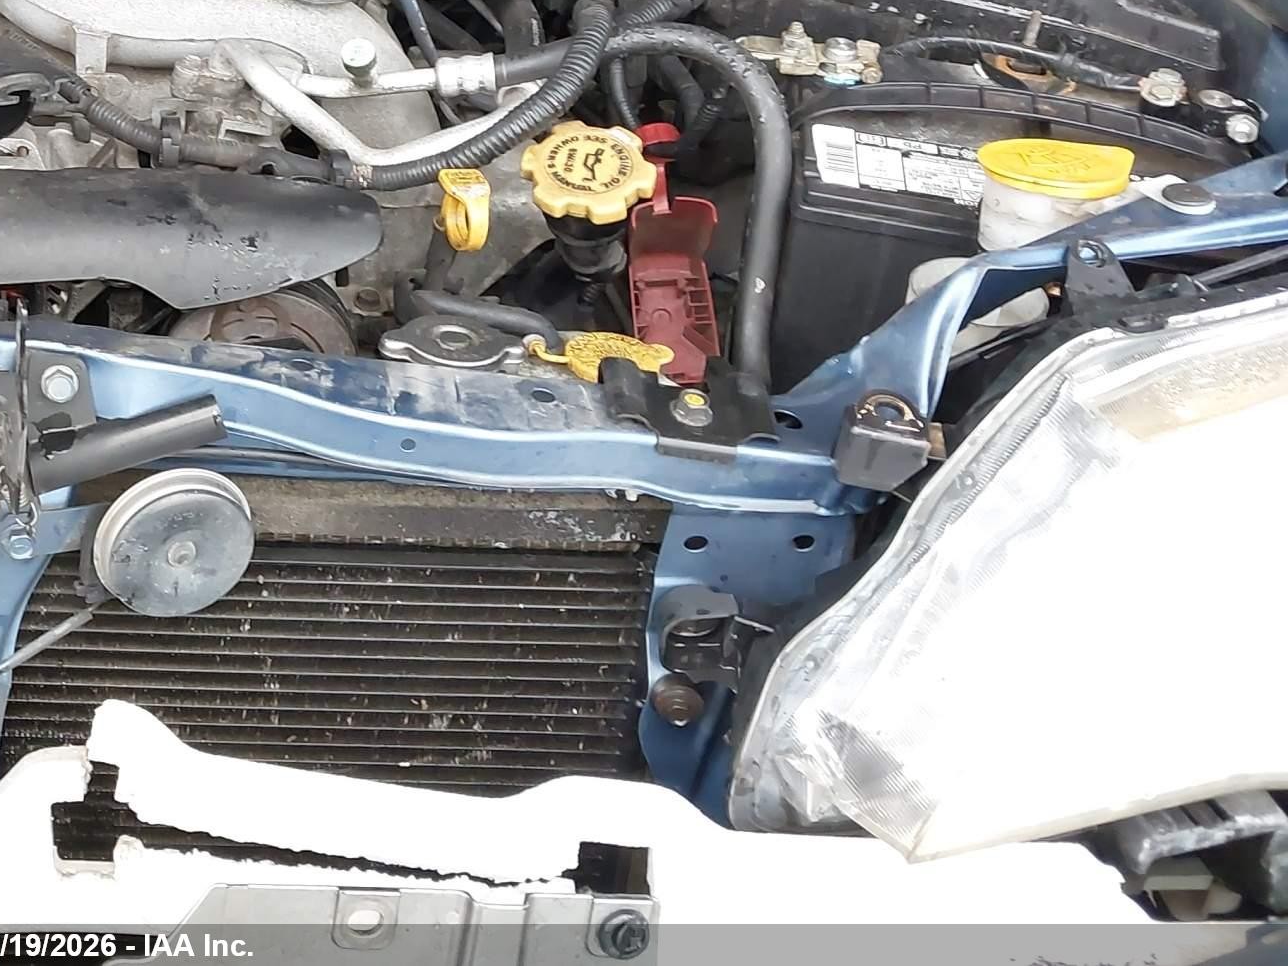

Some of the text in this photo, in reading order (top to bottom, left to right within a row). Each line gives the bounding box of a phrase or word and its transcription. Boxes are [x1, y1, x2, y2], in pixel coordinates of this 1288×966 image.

[584, 135, 608, 144] SEE
[601, 143, 631, 189] ENGINE OIL
